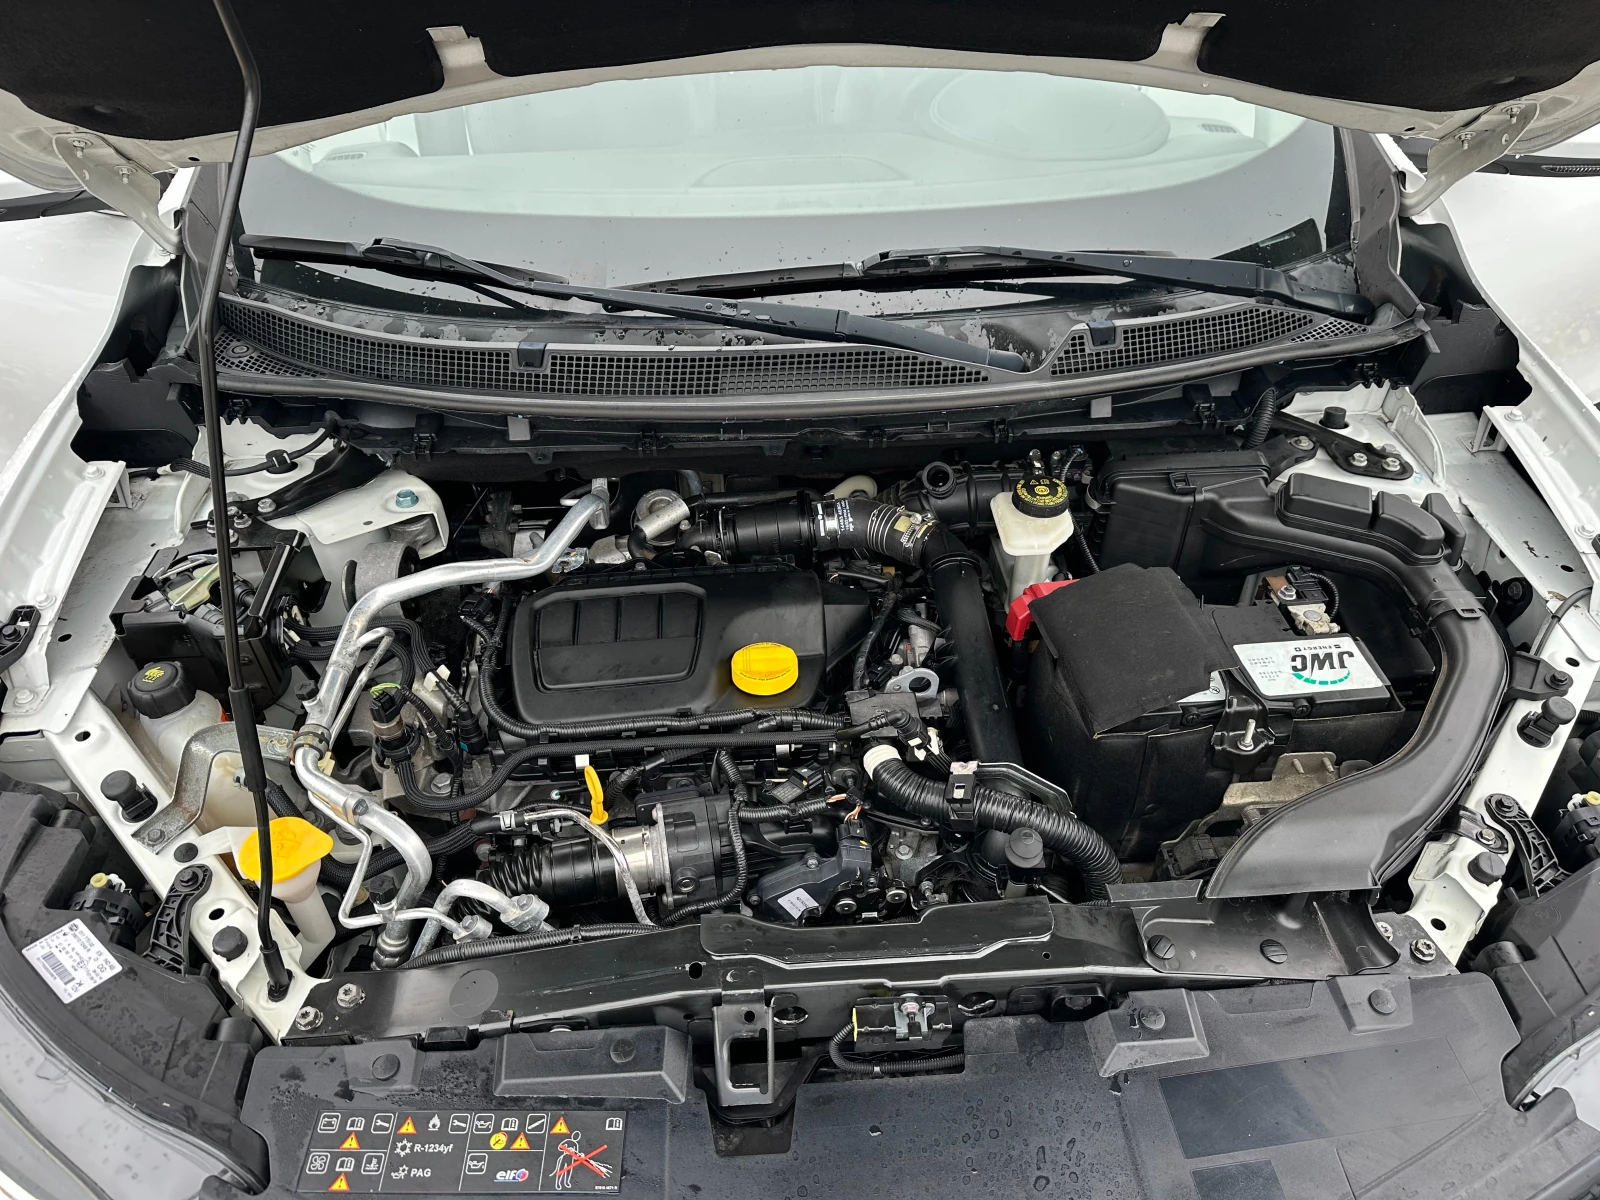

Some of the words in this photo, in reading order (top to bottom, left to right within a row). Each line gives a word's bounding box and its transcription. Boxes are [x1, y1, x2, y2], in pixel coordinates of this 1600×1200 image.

[1303, 644, 1332, 652] ENERGY
[1291, 651, 1354, 675] JWC
[413, 1142, 454, 1155] R-1234yf
[410, 1167, 432, 1178] PAG
